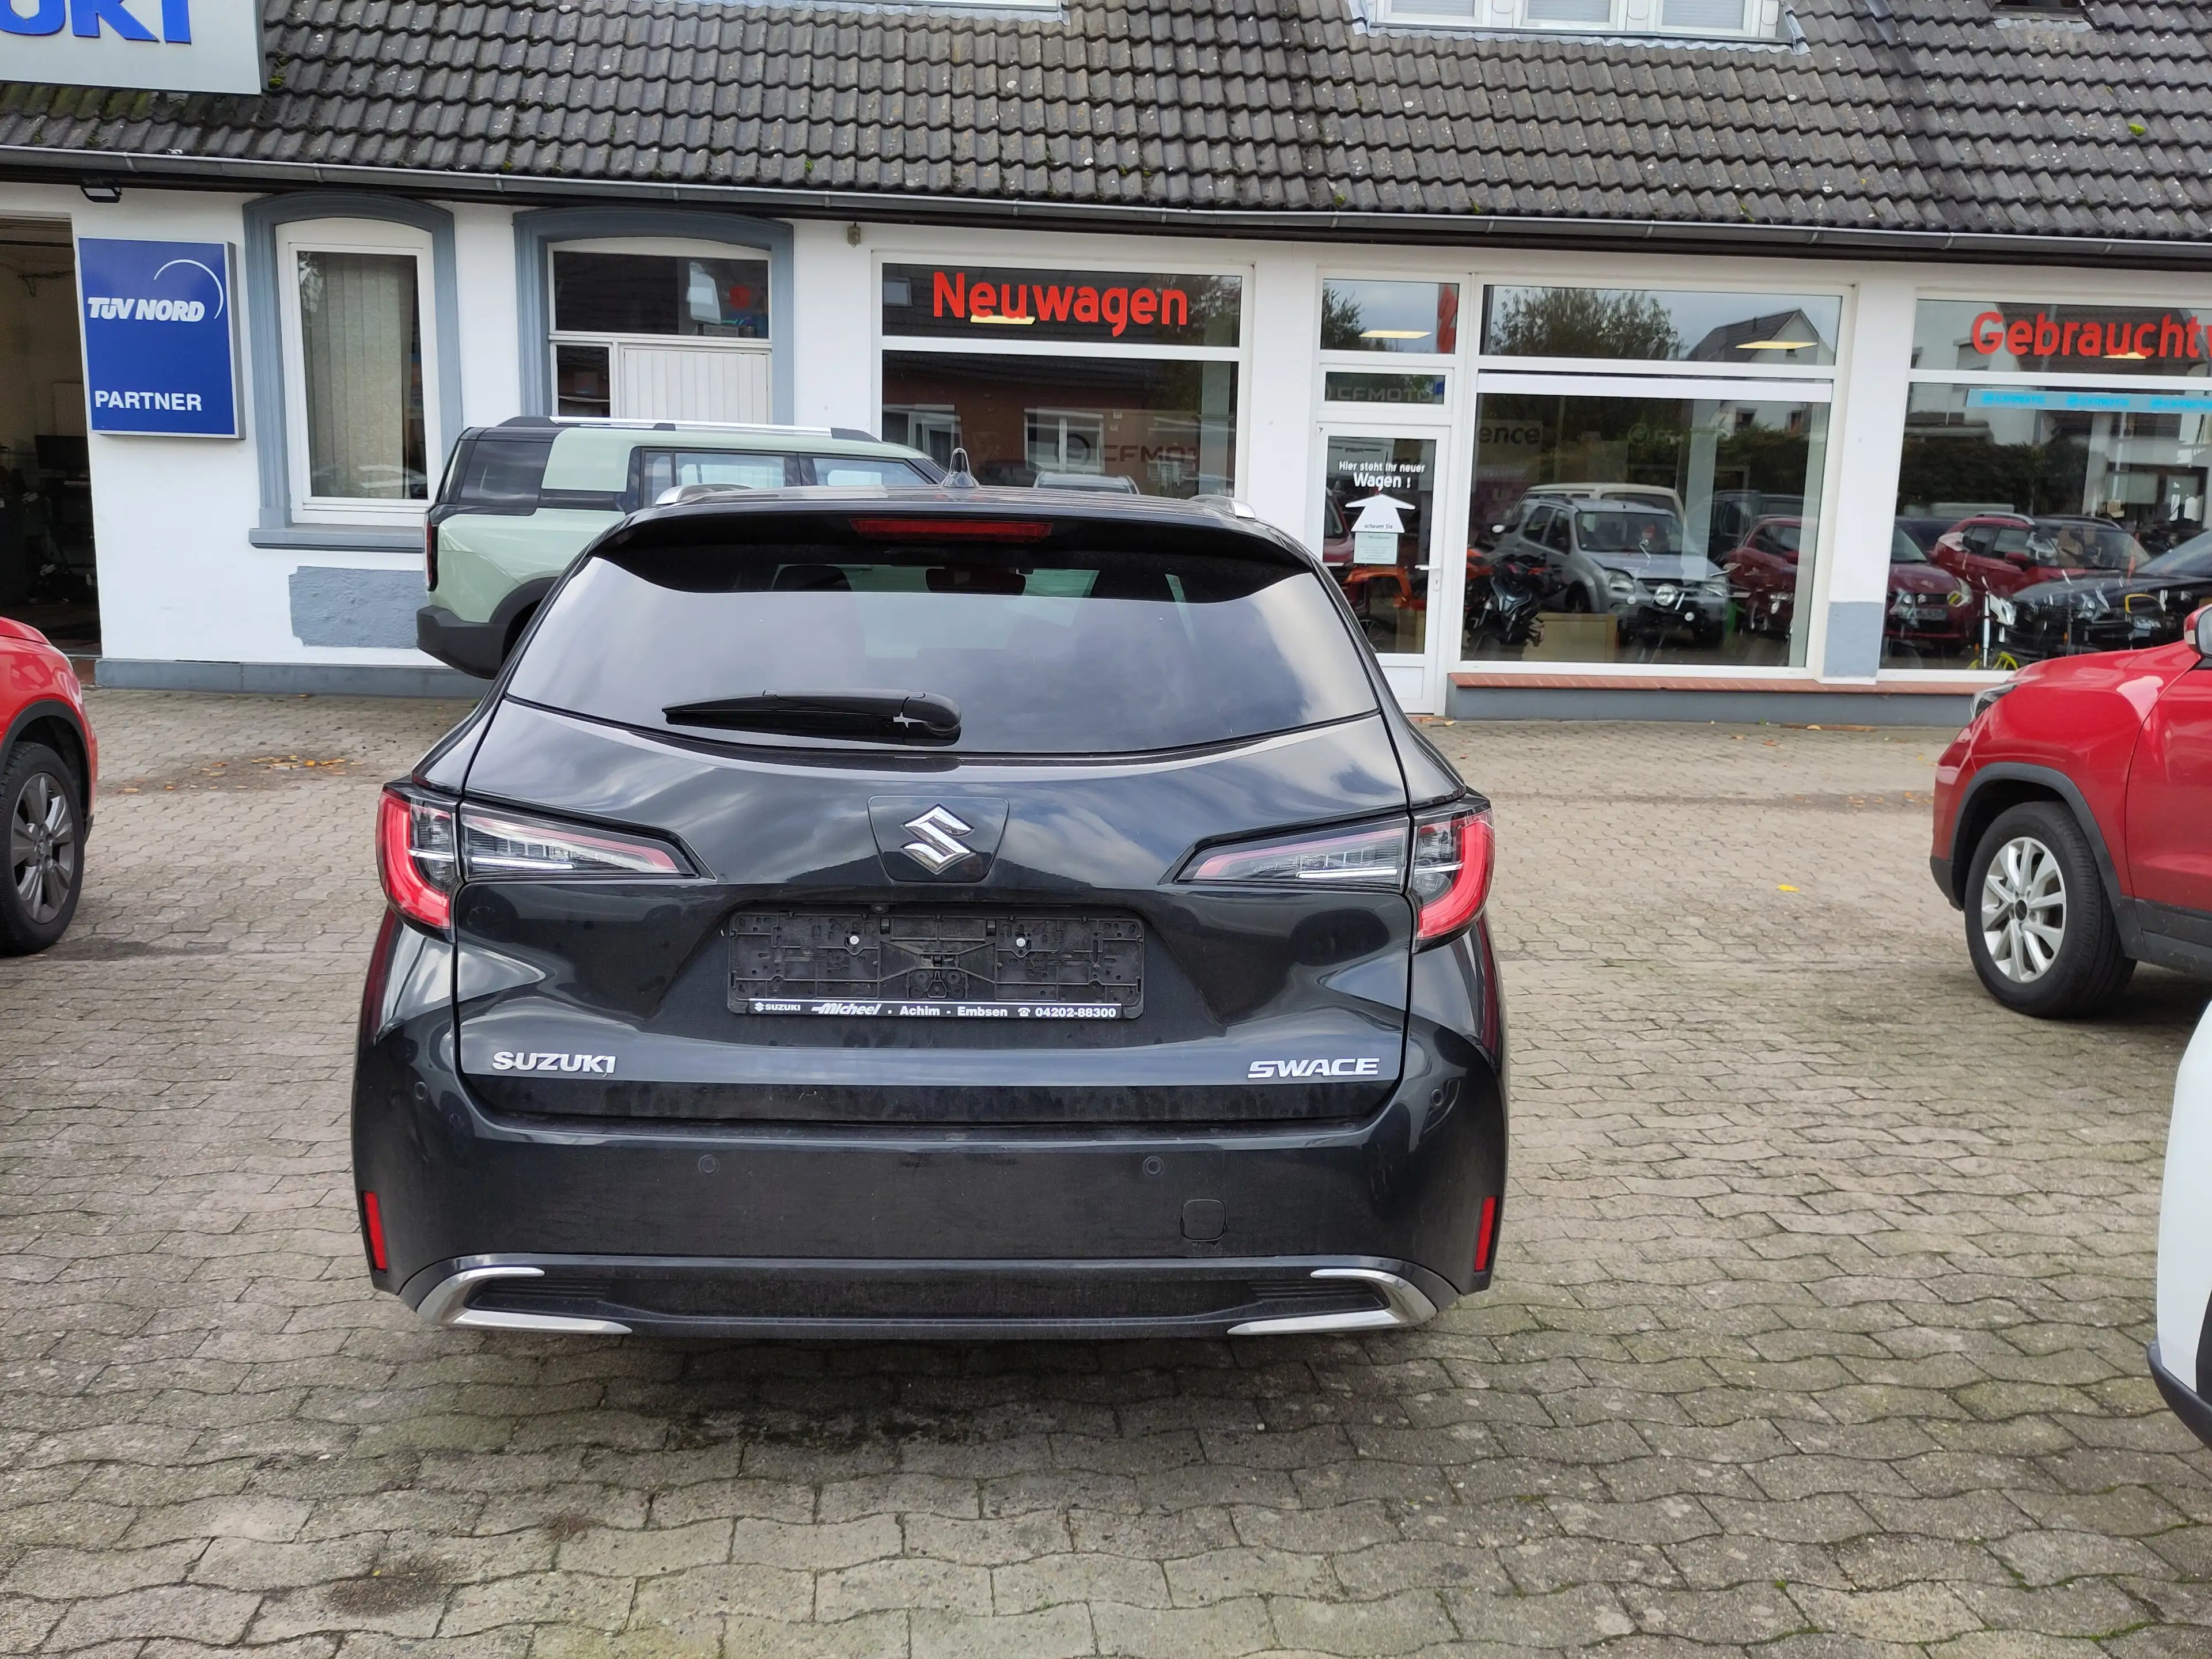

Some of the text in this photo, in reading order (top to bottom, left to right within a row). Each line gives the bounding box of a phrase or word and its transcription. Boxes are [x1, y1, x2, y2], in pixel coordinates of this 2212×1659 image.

[135, 298, 205, 323] NORD
[933, 271, 1187, 337] Neuwagen
[1971, 311, 2212, 358] Gebraucht
[94, 390, 202, 411] PARTNER
[1339, 460, 1426, 474] Hier steht Ihr neuer
[1353, 472, 1402, 492] Wagen
[764, 1003, 801, 1012] SUZUKI
[899, 1005, 941, 1016] Achim
[957, 1006, 1008, 1017] Embsen
[1035, 1007, 1117, 1018] 04202-88300
[492, 1051, 616, 1074] SUZUKI
[1247, 1058, 1380, 1079] SWACE
